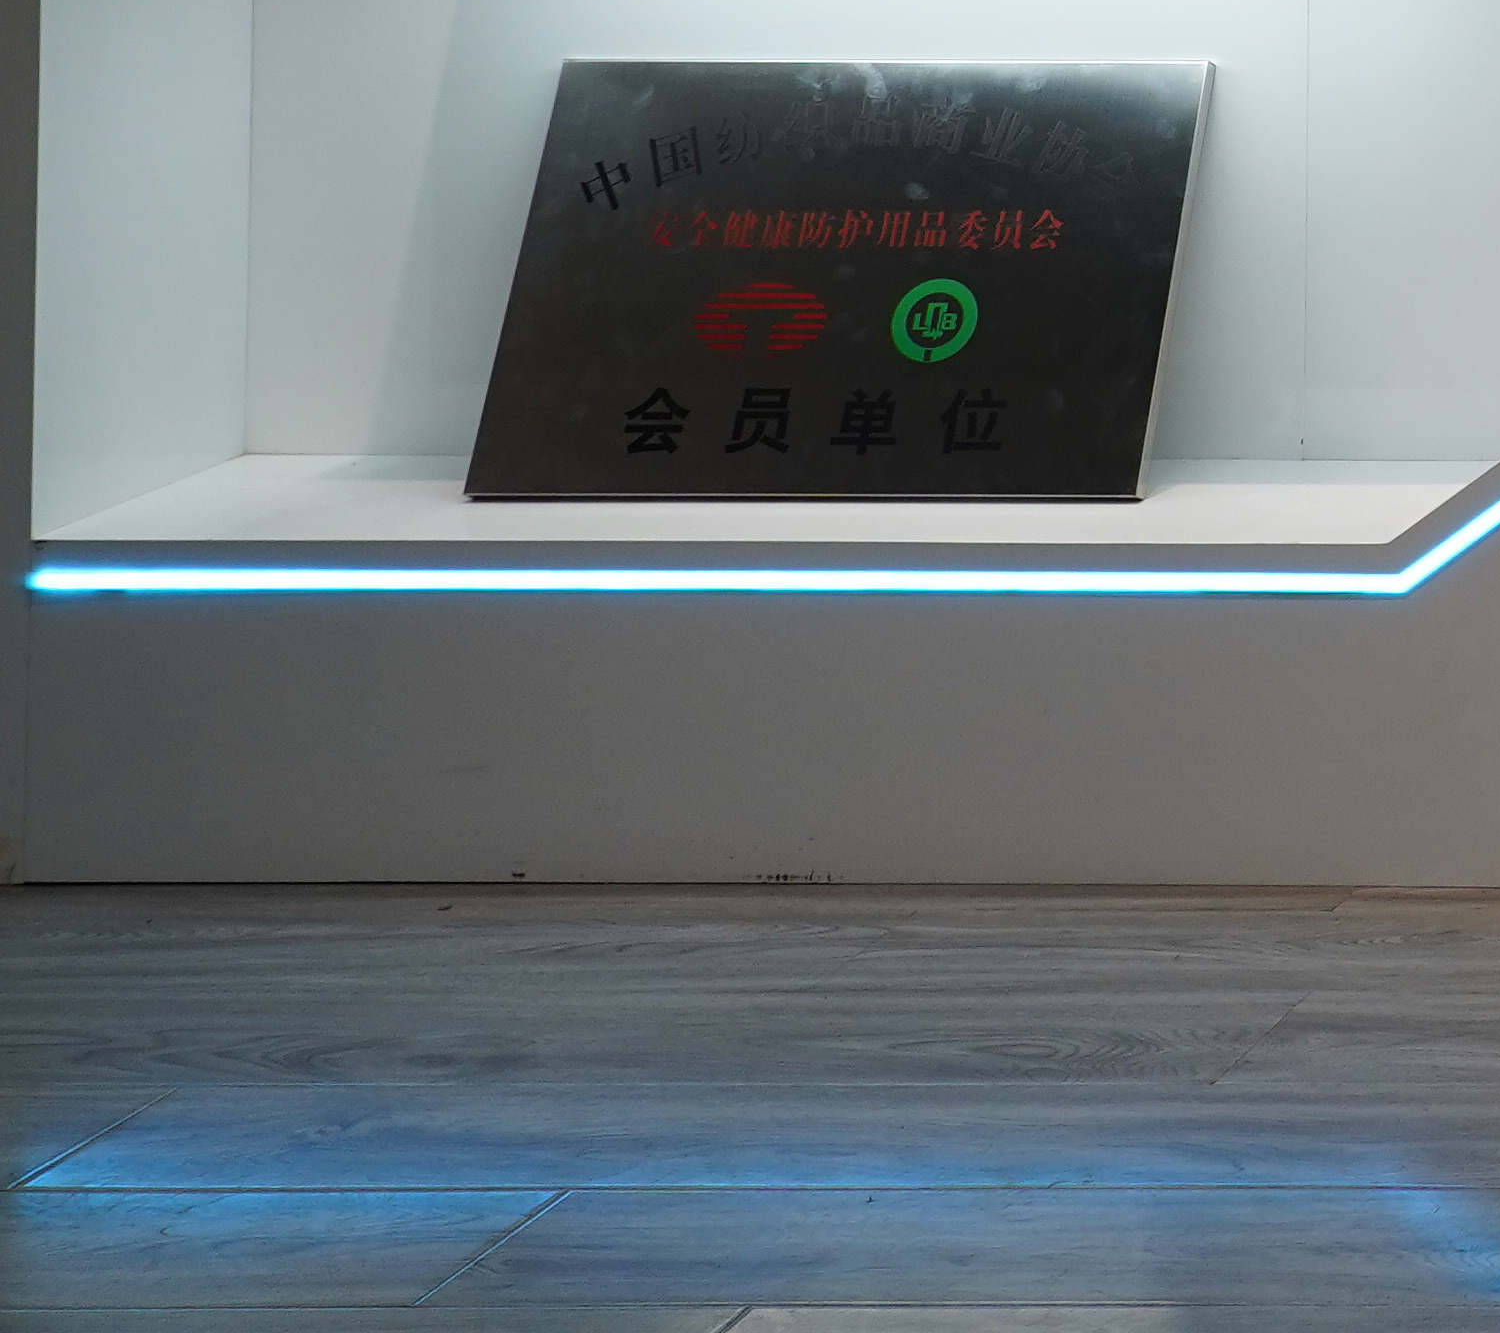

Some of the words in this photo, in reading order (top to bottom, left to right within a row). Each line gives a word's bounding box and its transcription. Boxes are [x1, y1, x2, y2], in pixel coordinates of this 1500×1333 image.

[580, 95, 1147, 211] 中国纺织品商业协会
[647, 208, 1066, 251] 安全健康防护用品委员会
[623, 386, 1007, 455] 会员单位
